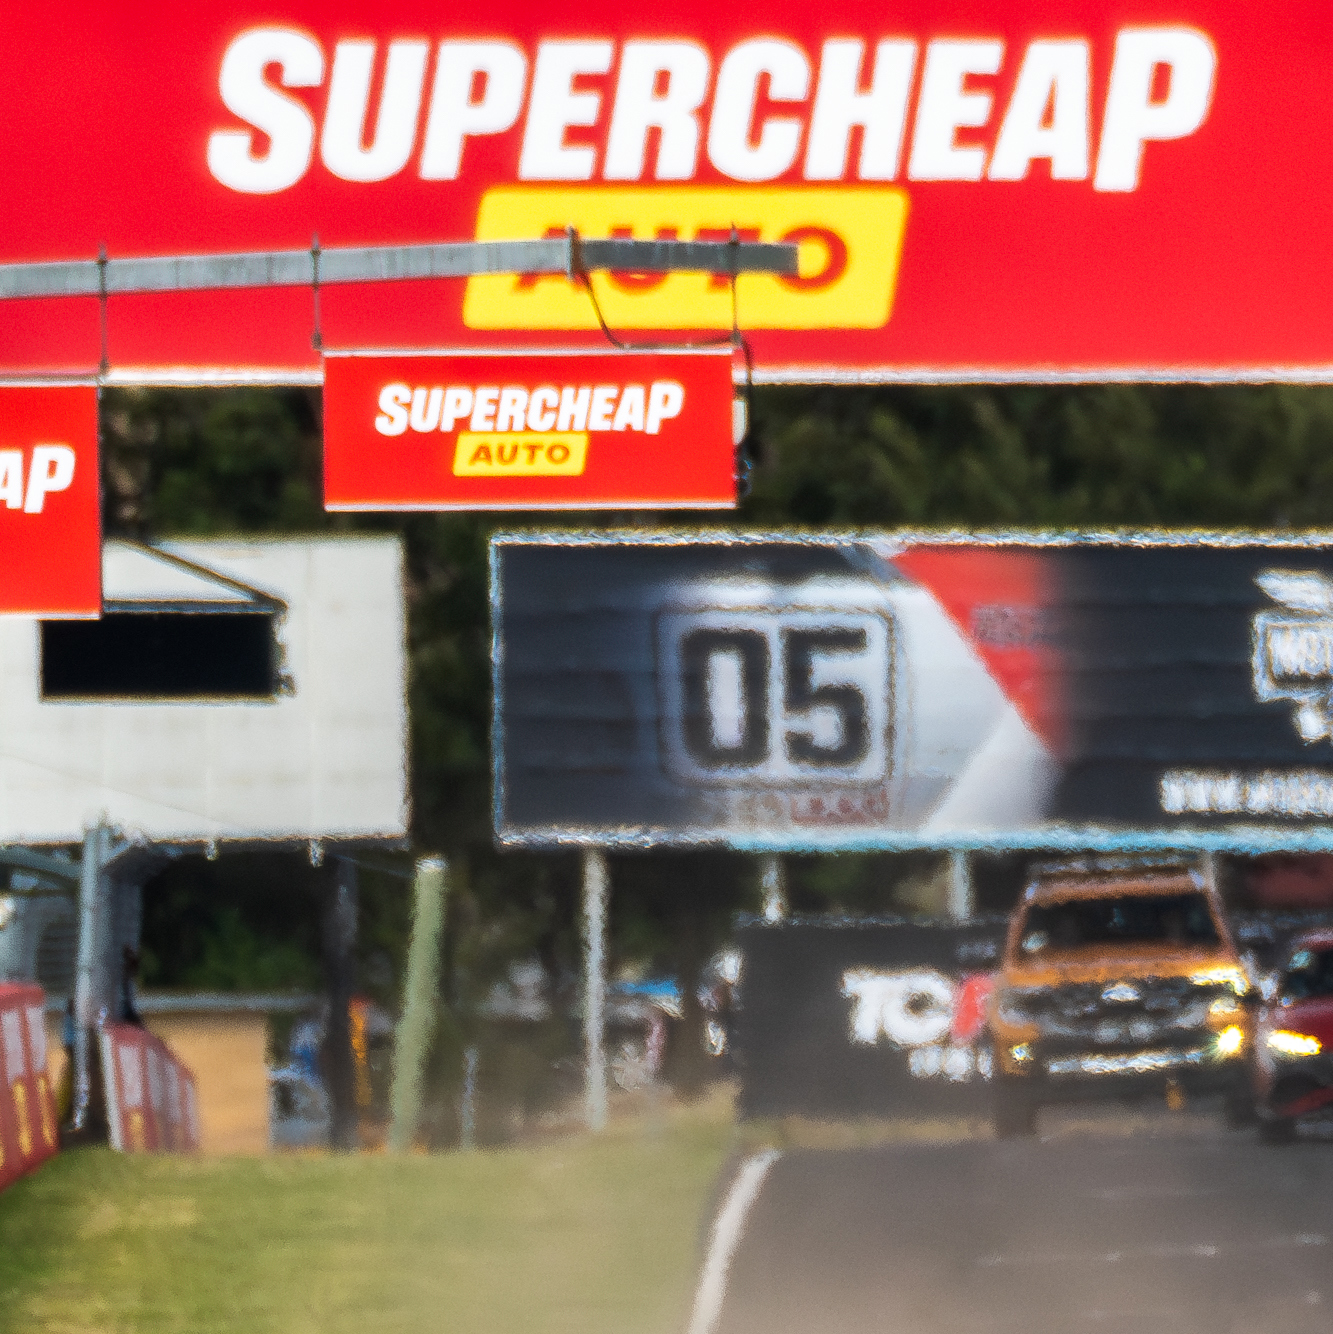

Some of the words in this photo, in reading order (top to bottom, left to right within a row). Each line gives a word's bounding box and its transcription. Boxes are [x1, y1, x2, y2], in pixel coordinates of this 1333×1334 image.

[207, 27, 1217, 196] SUPERCHEAP
[512, 225, 850, 294] AUTO
[375, 381, 684, 436] SUPERCHEAP
[470, 440, 571, 466] AUTO
[679, 626, 872, 770] 05
